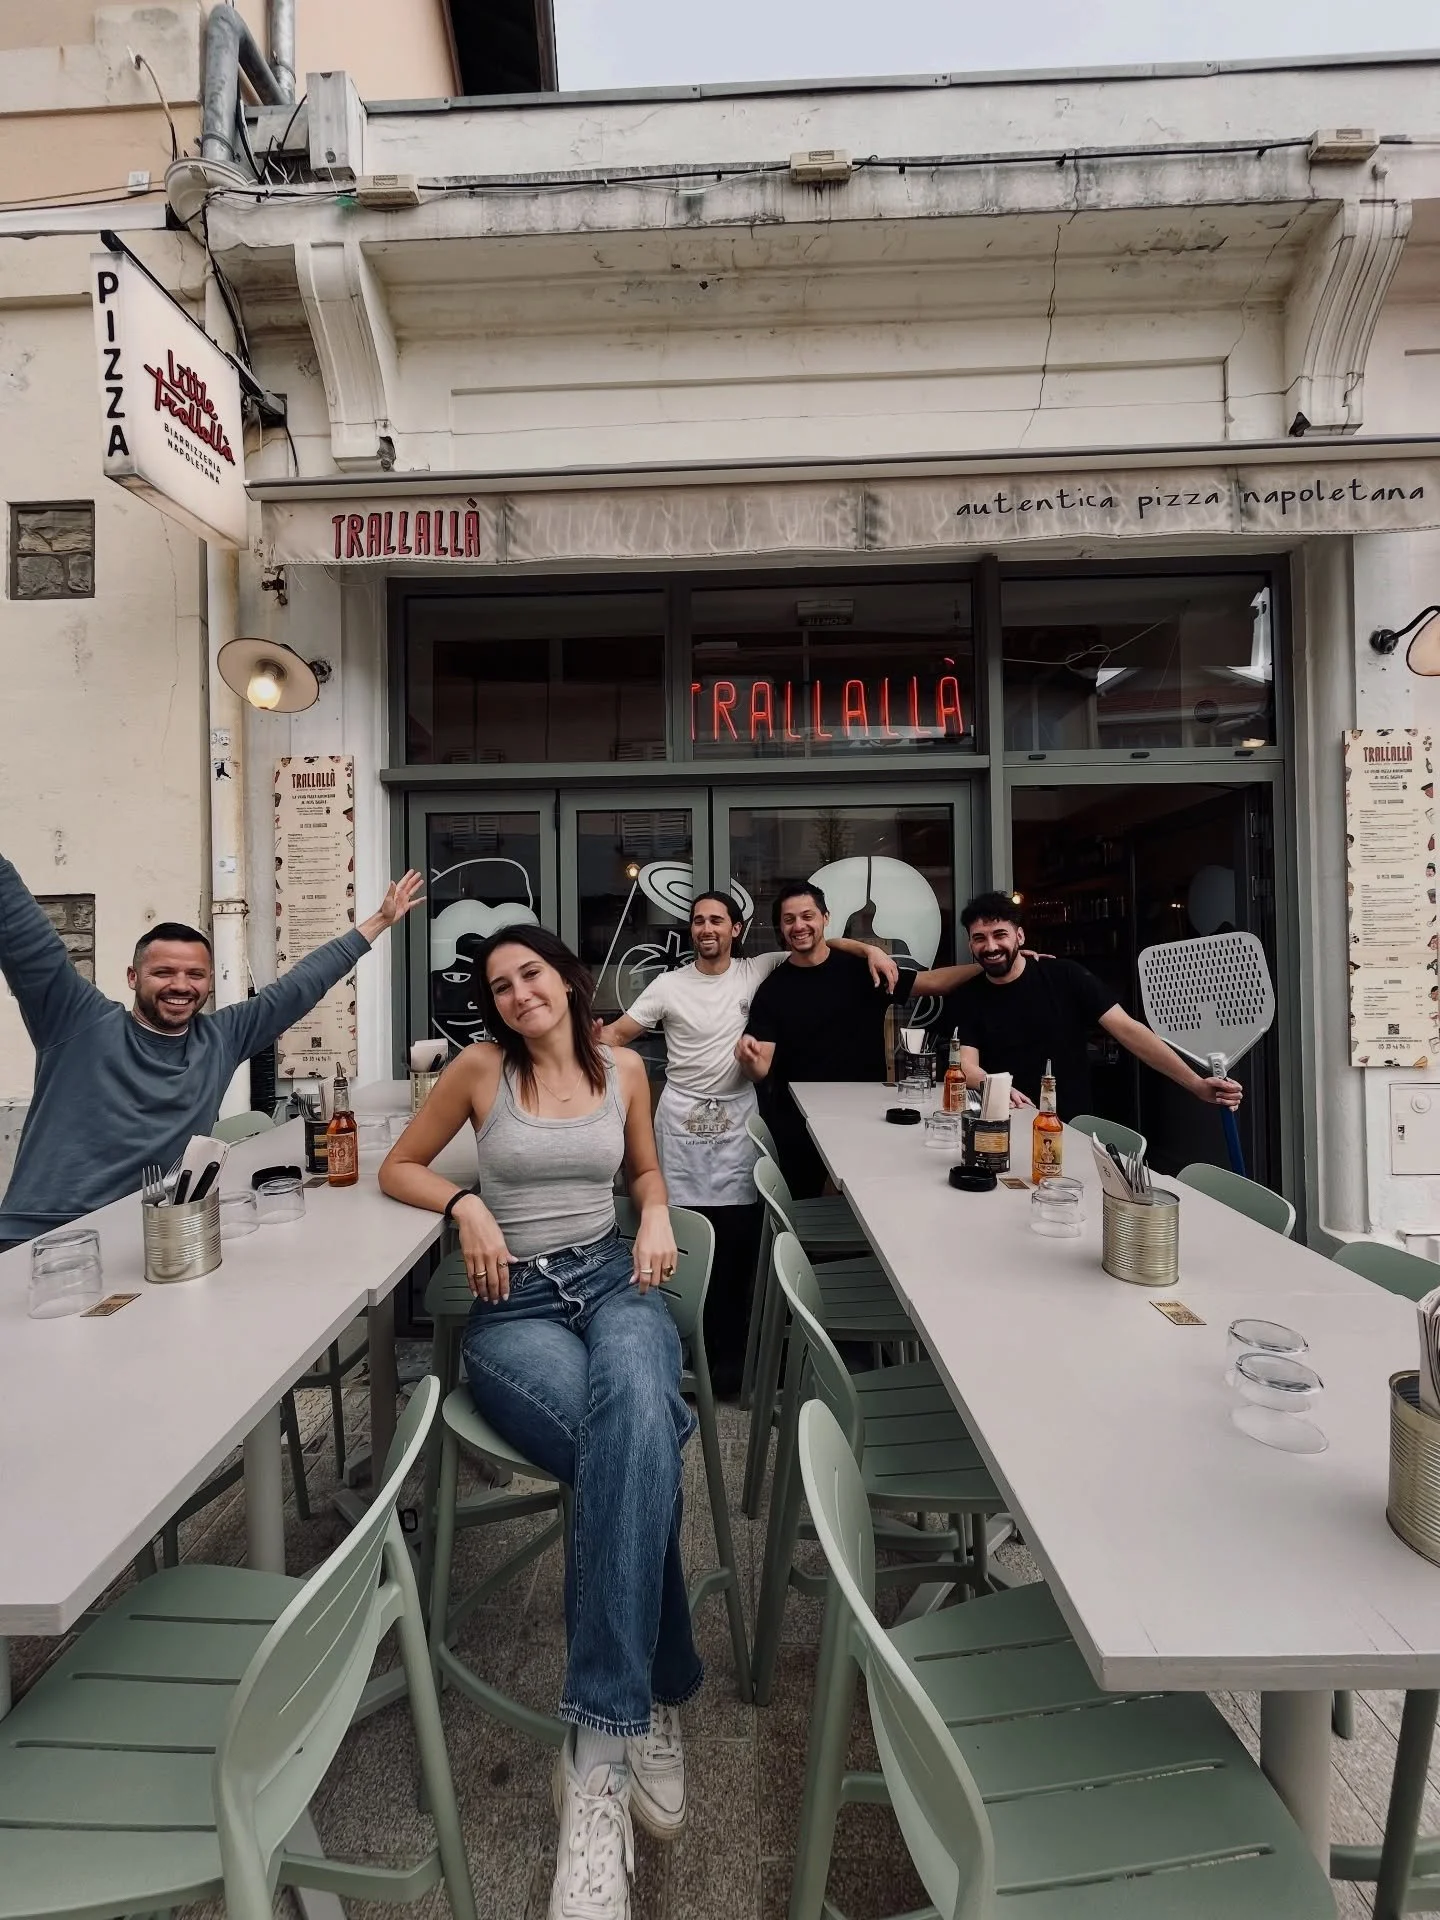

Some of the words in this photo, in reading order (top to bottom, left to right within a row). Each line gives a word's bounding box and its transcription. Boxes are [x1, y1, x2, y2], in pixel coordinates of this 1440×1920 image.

[98, 271, 130, 457] PIZZA
[164, 422, 222, 475] BIARRIZZERIA
[167, 438, 221, 485] NAPOLETANA
[956, 487, 1115, 517] autentica
[1137, 486, 1219, 519] pizza
[1243, 479, 1426, 515] napoletana
[332, 497, 481, 560] TRALLALLÀ
[690, 1123, 727, 1132] CAPUTO
[328, 1147, 346, 1158] BIO
